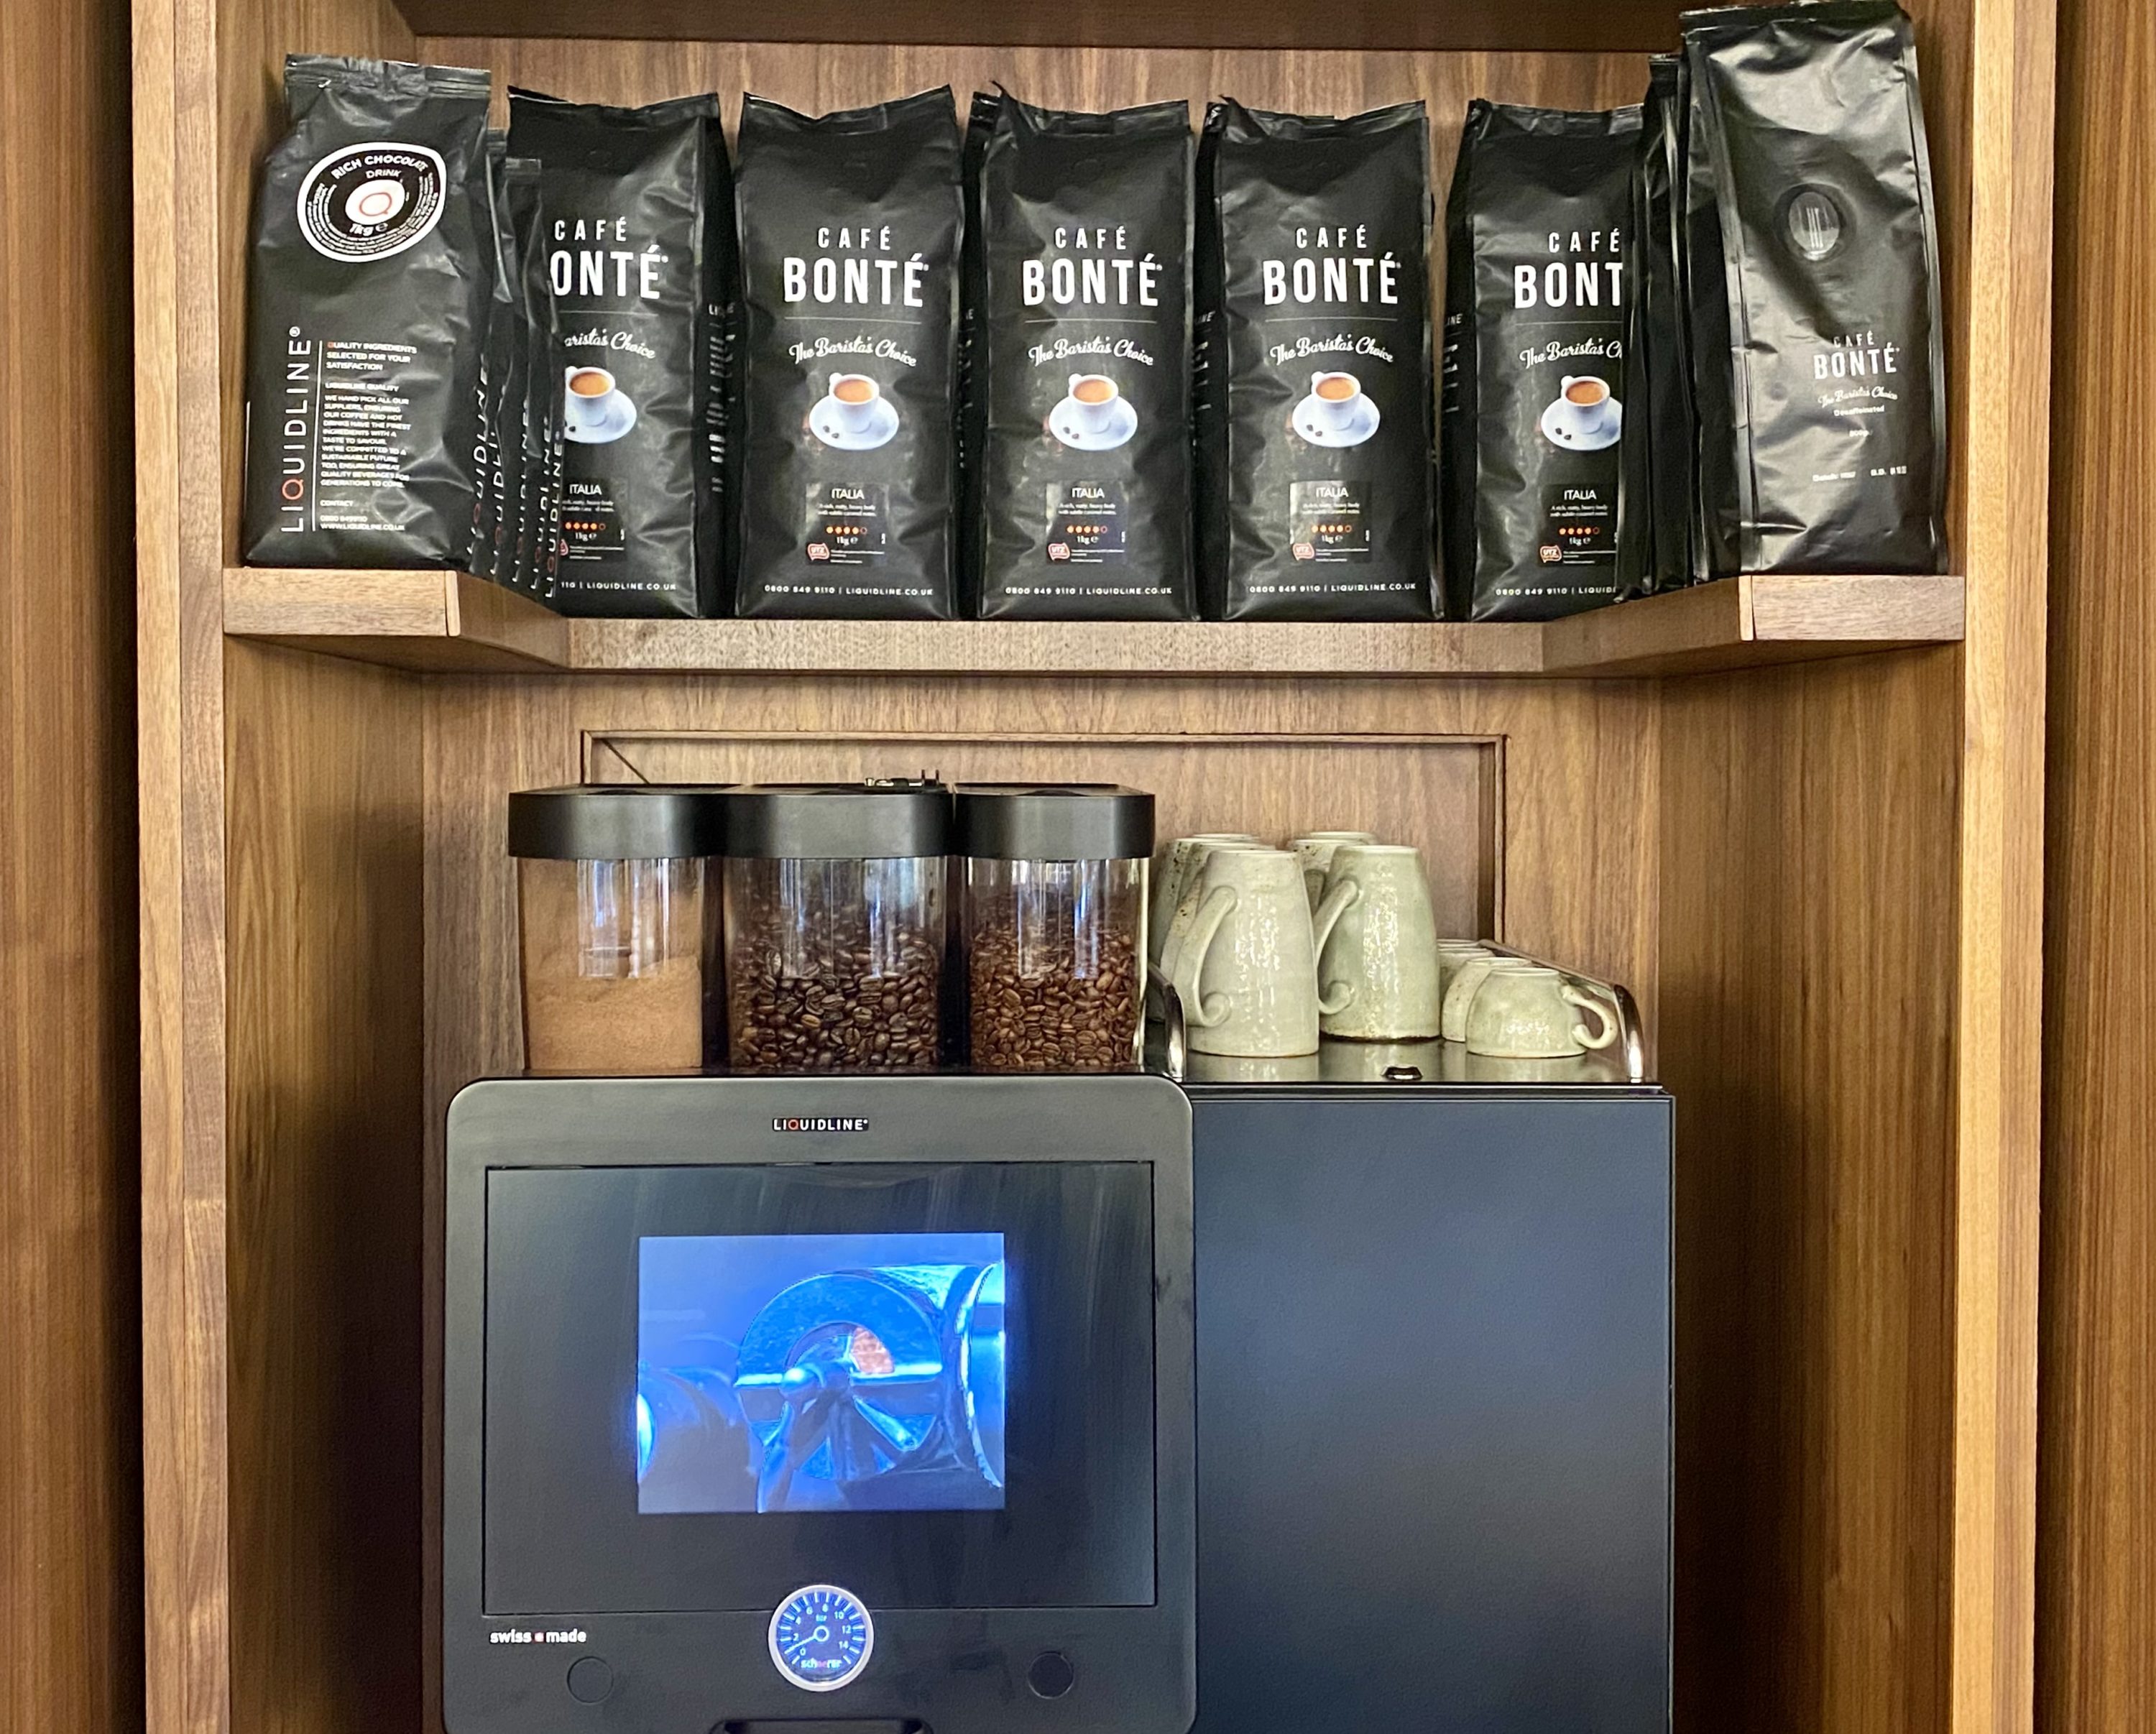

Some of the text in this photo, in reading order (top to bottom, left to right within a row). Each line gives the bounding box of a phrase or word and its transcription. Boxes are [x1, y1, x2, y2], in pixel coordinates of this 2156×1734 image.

[331, 155, 429, 180] RICH CHOCOLATE
[365, 169, 402, 179] DRINK
[554, 216, 627, 241] CAFÉ
[818, 226, 890, 250] CAFÉ
[1054, 226, 1126, 250] CAFÉ
[1296, 224, 1367, 249] CAFÉ
[1549, 228, 1620, 253] CAFÉ
[550, 244, 661, 300] ONTÉ
[783, 253, 925, 308] BONTÉ
[1023, 253, 1159, 307] BONTÉ
[1263, 252, 1399, 305] BONTÉ
[1514, 262, 1623, 309] BONT
[363, 343, 417, 354] INGREDIENTS
[564, 328, 655, 359] arista's Choice
[1028, 336, 1153, 366] The Barista's Choice
[1270, 333, 1393, 366] The Barista's Choice
[1834, 330, 1874, 348] CAFÉ
[387, 354, 410, 363] YOUR
[788, 336, 917, 367] The Barista's Choice
[1519, 346, 1545, 369] The
[1546, 337, 1604, 361] Barista's
[1813, 342, 1897, 379] BONTÉ
[326, 361, 383, 370] SATISFACTION
[367, 383, 399, 392] QUALITY
[569, 484, 602, 495] ITALIA
[831, 488, 865, 499] ITALIA
[1072, 487, 1105, 499] ITALIA
[1316, 486, 1349, 497] ITALIA
[1564, 489, 1597, 500] ITALIA
[846, 587, 933, 596] LIQUIDLINE.CO.UK
[1086, 586, 1172, 595] LIQUIDLINE.CO.UK
[1331, 583, 1416, 592] LIQUIDLINE.CO.UK
[489, 1628, 587, 1643] swiss made
